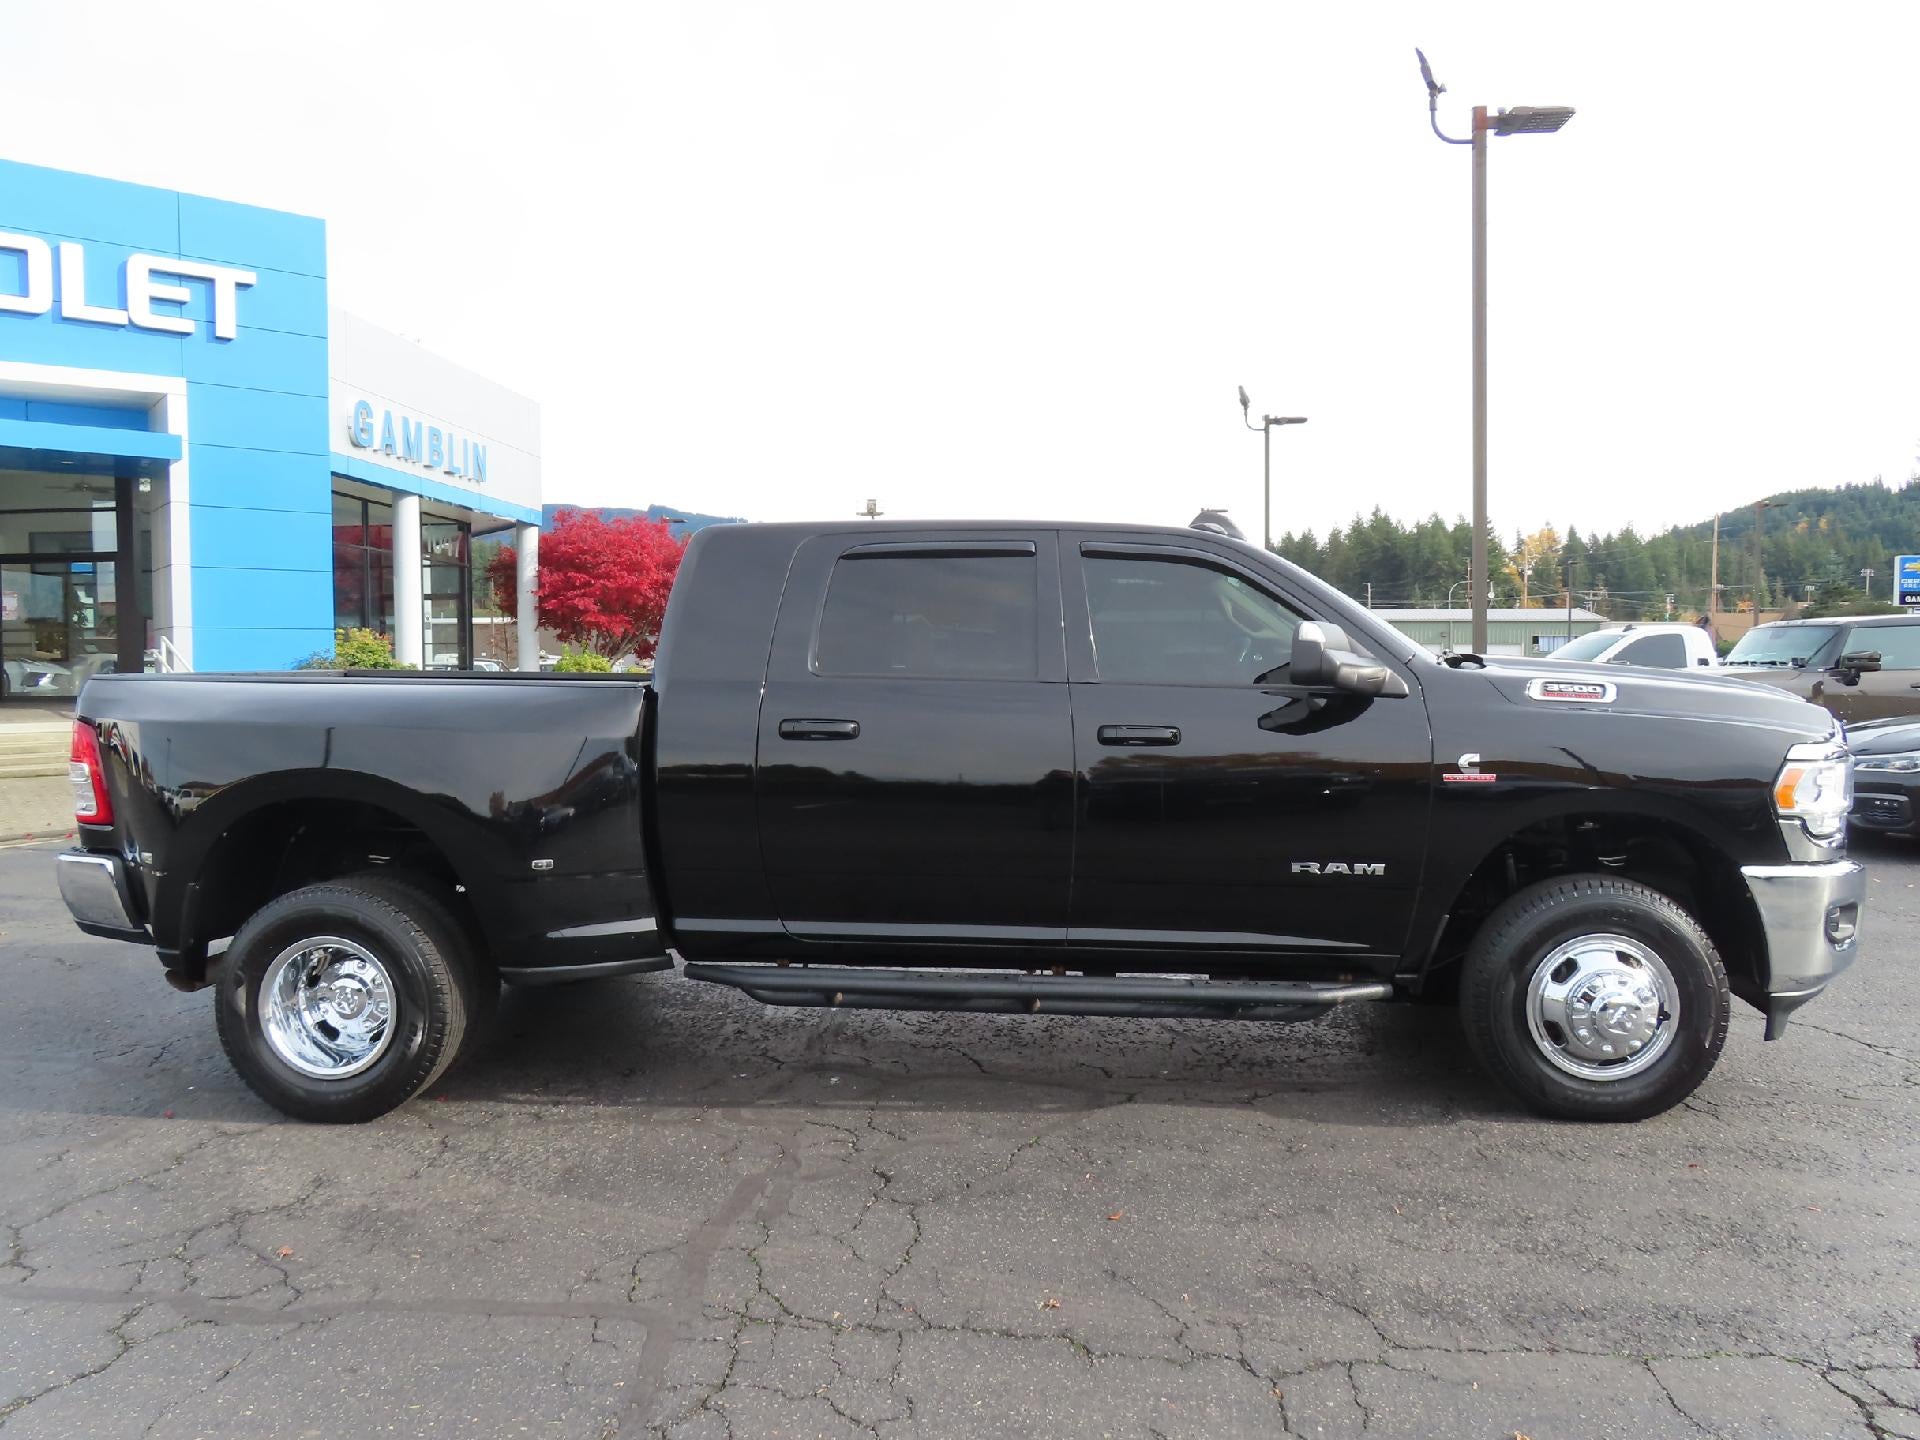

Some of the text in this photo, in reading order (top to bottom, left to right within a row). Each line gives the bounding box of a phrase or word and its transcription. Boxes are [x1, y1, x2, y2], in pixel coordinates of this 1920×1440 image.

[351, 400, 487, 483] GAMBLIN
[1544, 683, 1602, 693] 3500
[1291, 862, 1386, 875] RAM
